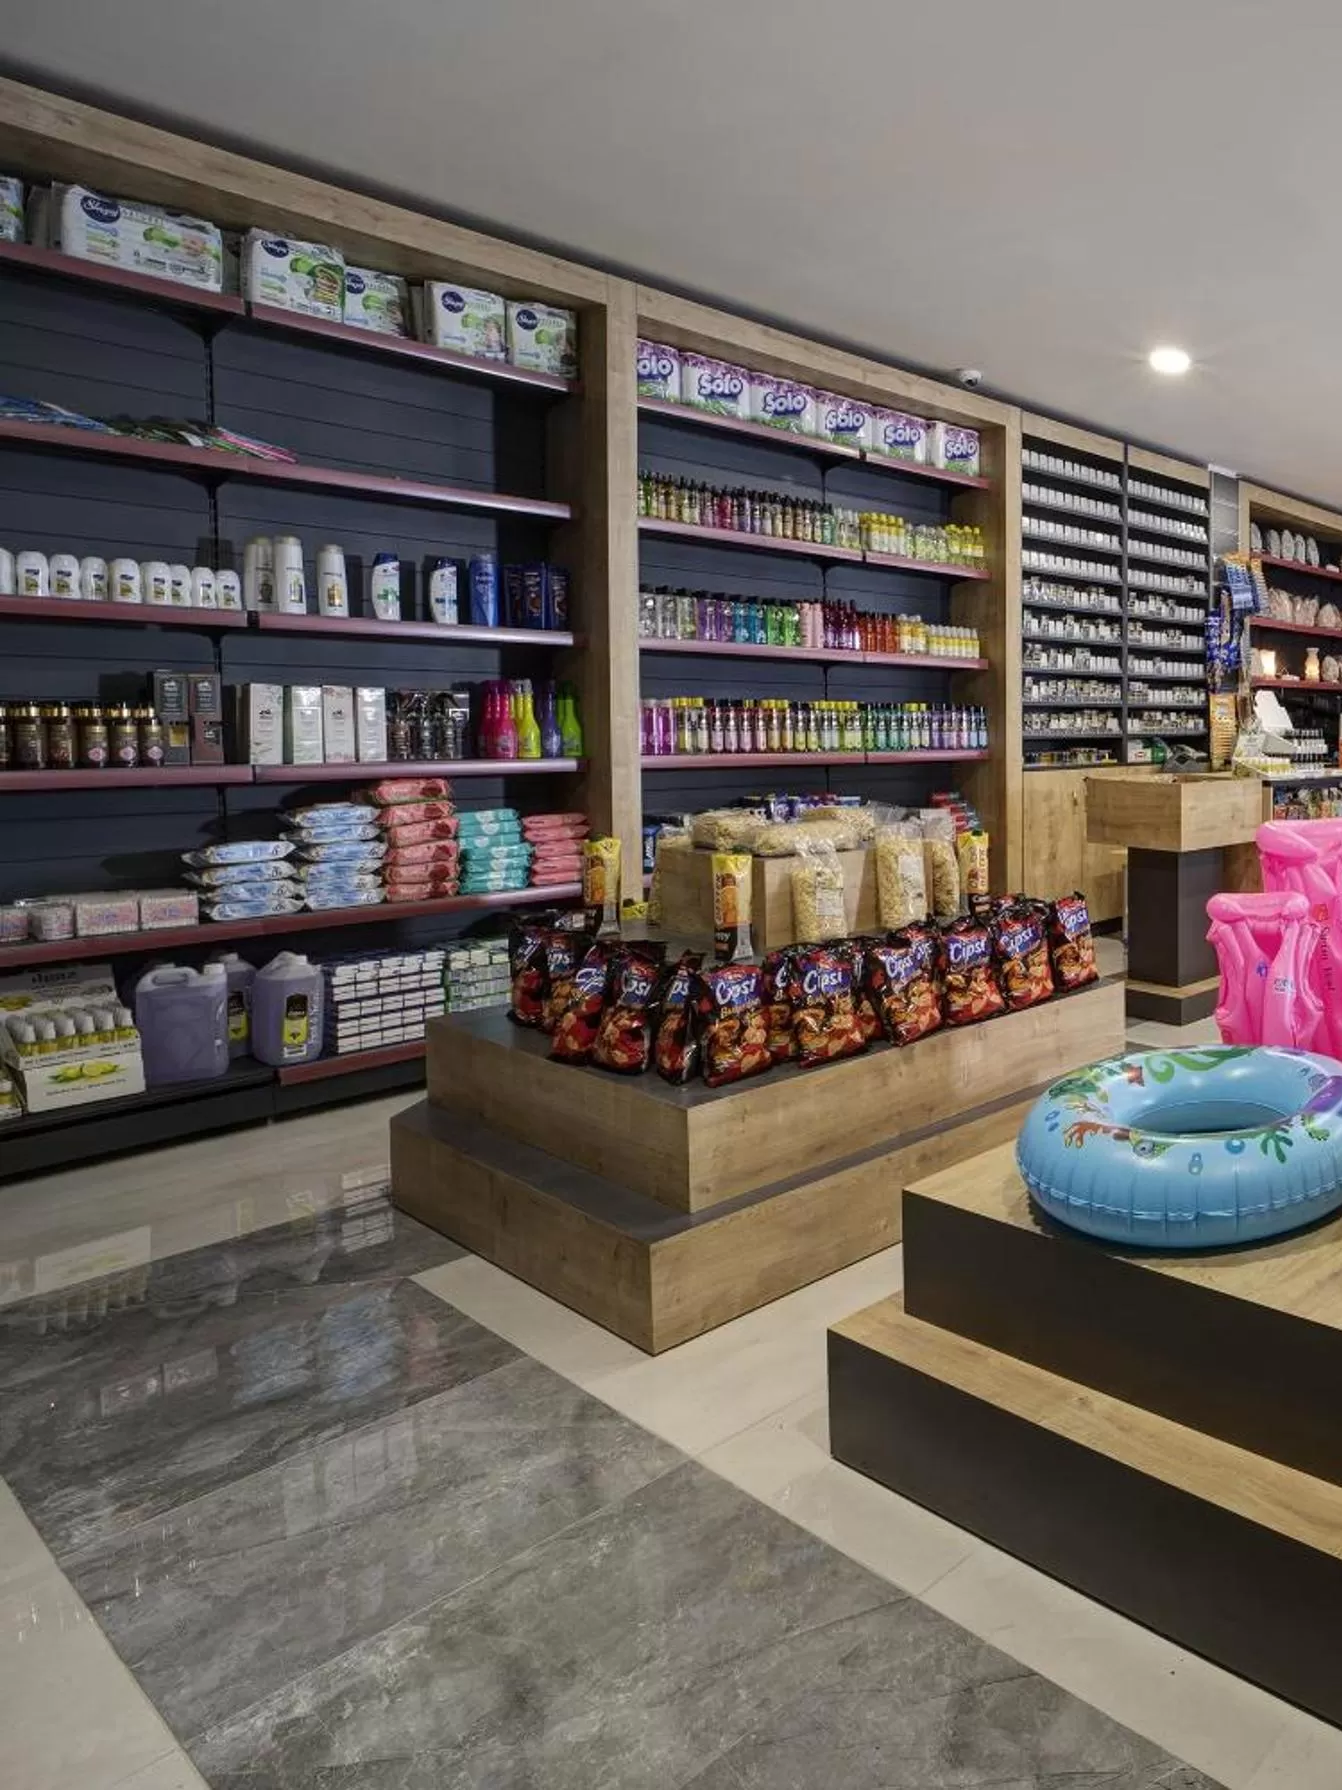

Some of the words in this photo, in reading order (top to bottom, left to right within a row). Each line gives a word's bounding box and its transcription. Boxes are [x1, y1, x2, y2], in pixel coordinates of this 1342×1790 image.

[638, 355, 673, 377] olo
[699, 371, 742, 397] Solo
[764, 391, 806, 415] Solo
[826, 410, 865, 431] Solo
[884, 423, 921, 445] Solo
[945, 438, 978, 457] Solo
